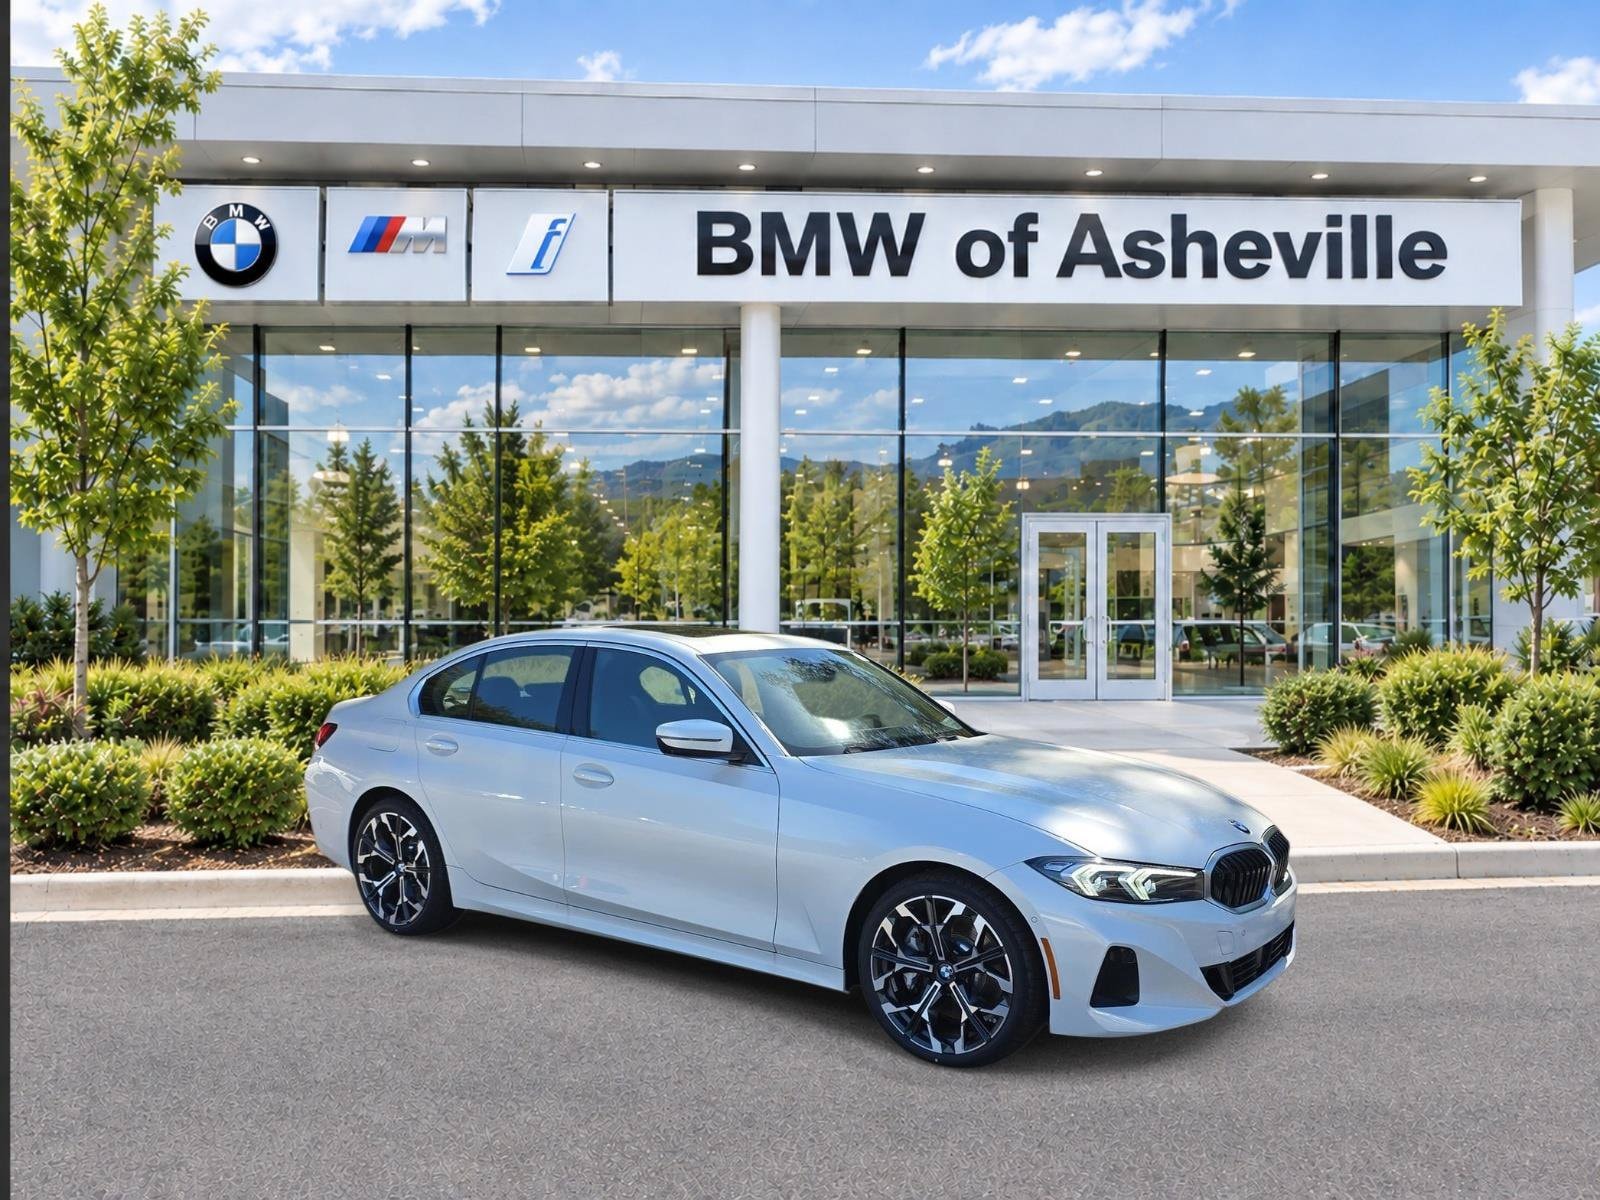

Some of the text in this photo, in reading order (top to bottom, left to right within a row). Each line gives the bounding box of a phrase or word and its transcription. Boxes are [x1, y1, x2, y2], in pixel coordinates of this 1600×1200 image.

[202, 203, 271, 231] BMW
[389, 215, 447, 254] M
[696, 210, 1448, 281] BMW of Asheville
